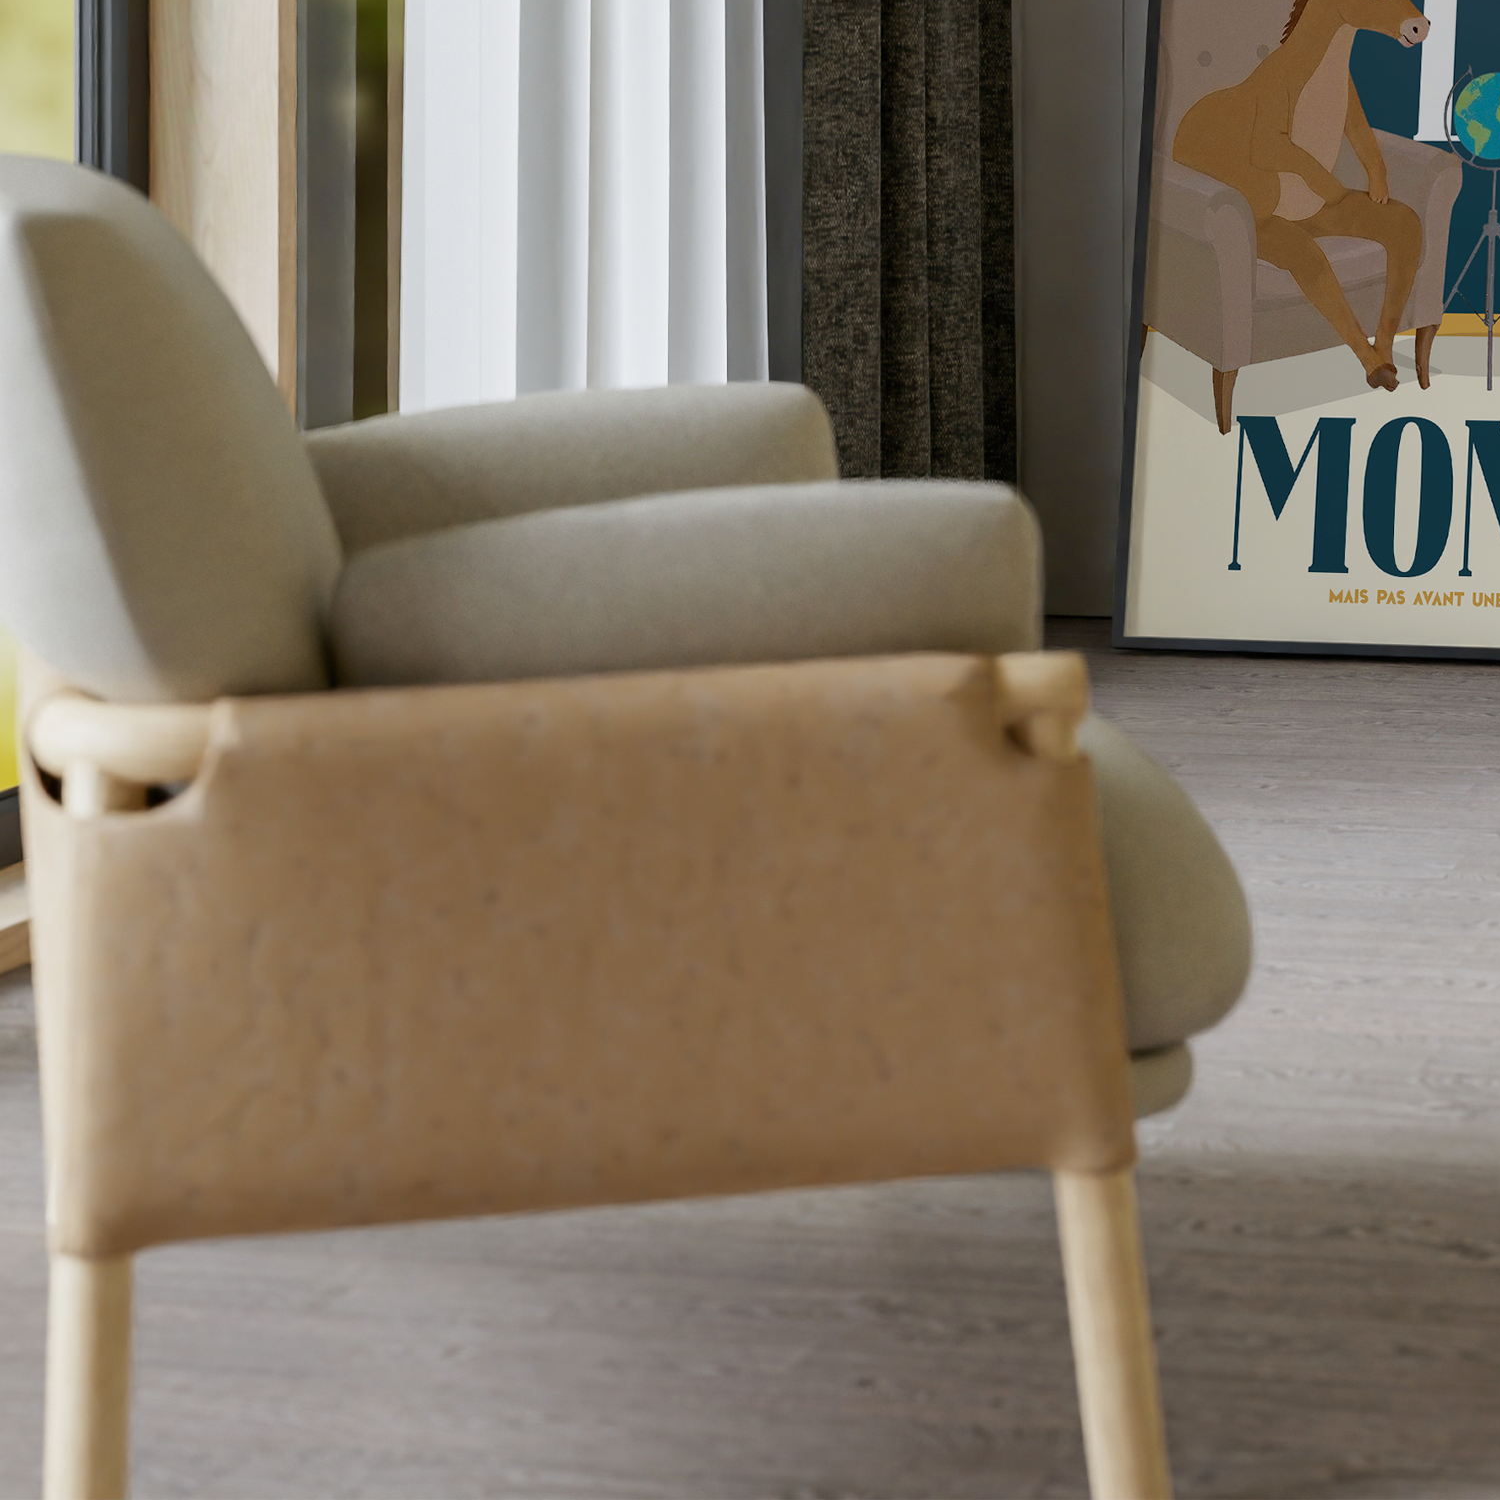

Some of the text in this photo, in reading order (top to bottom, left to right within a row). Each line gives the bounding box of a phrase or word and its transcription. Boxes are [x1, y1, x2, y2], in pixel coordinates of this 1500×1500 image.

[1329, 589, 1368, 604] MAIS
[1377, 590, 1405, 605] PAS
[1413, 591, 1464, 606] AVANT
